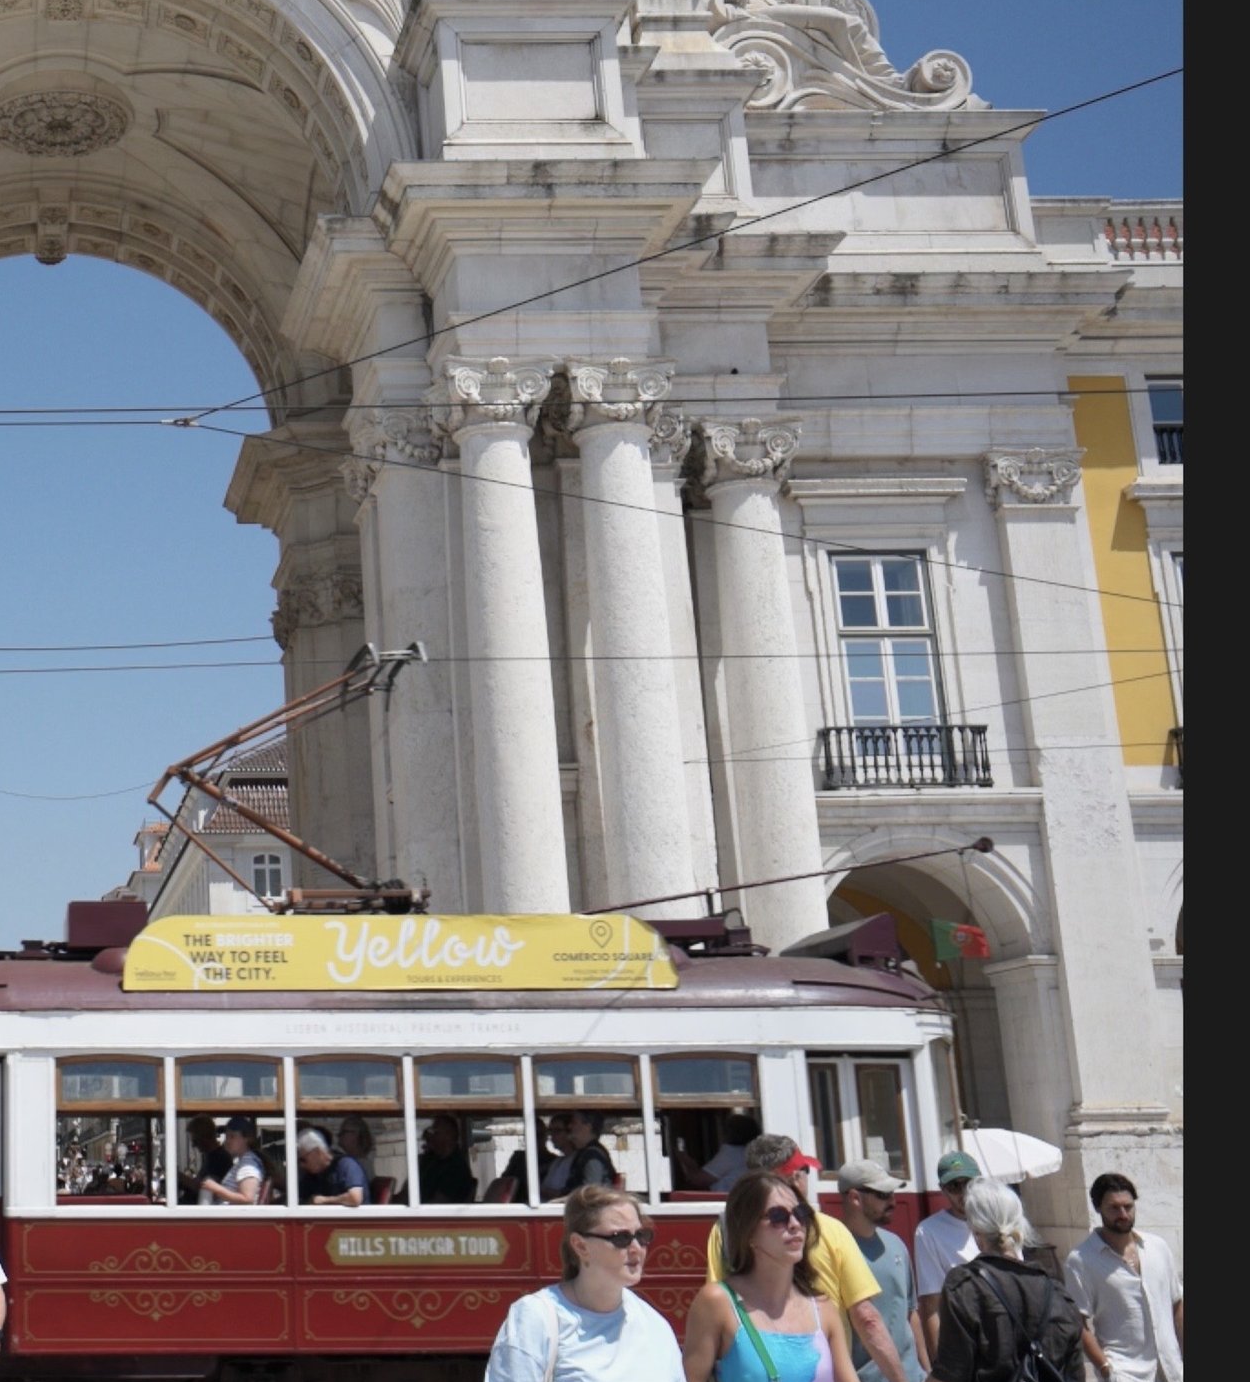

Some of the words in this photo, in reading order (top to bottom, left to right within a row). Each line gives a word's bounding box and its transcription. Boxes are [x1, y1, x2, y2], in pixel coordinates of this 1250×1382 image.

[183, 934, 212, 947] THE
[215, 933, 294, 947] BRIGHTER
[190, 950, 225, 963] WAY
[230, 950, 251, 963] TO
[255, 950, 288, 963] FEEL
[324, 918, 526, 984] Yellow
[613, 952, 653, 962] SQUARE
[203, 967, 232, 980] THE
[236, 967, 276, 980] CITY.
[445, 974, 502, 983] EXPERIENCES
[338, 1236, 385, 1256] HILLS
[388, 1236, 454, 1256] TRAMCAR
[458, 1235, 499, 1255] TOUR
